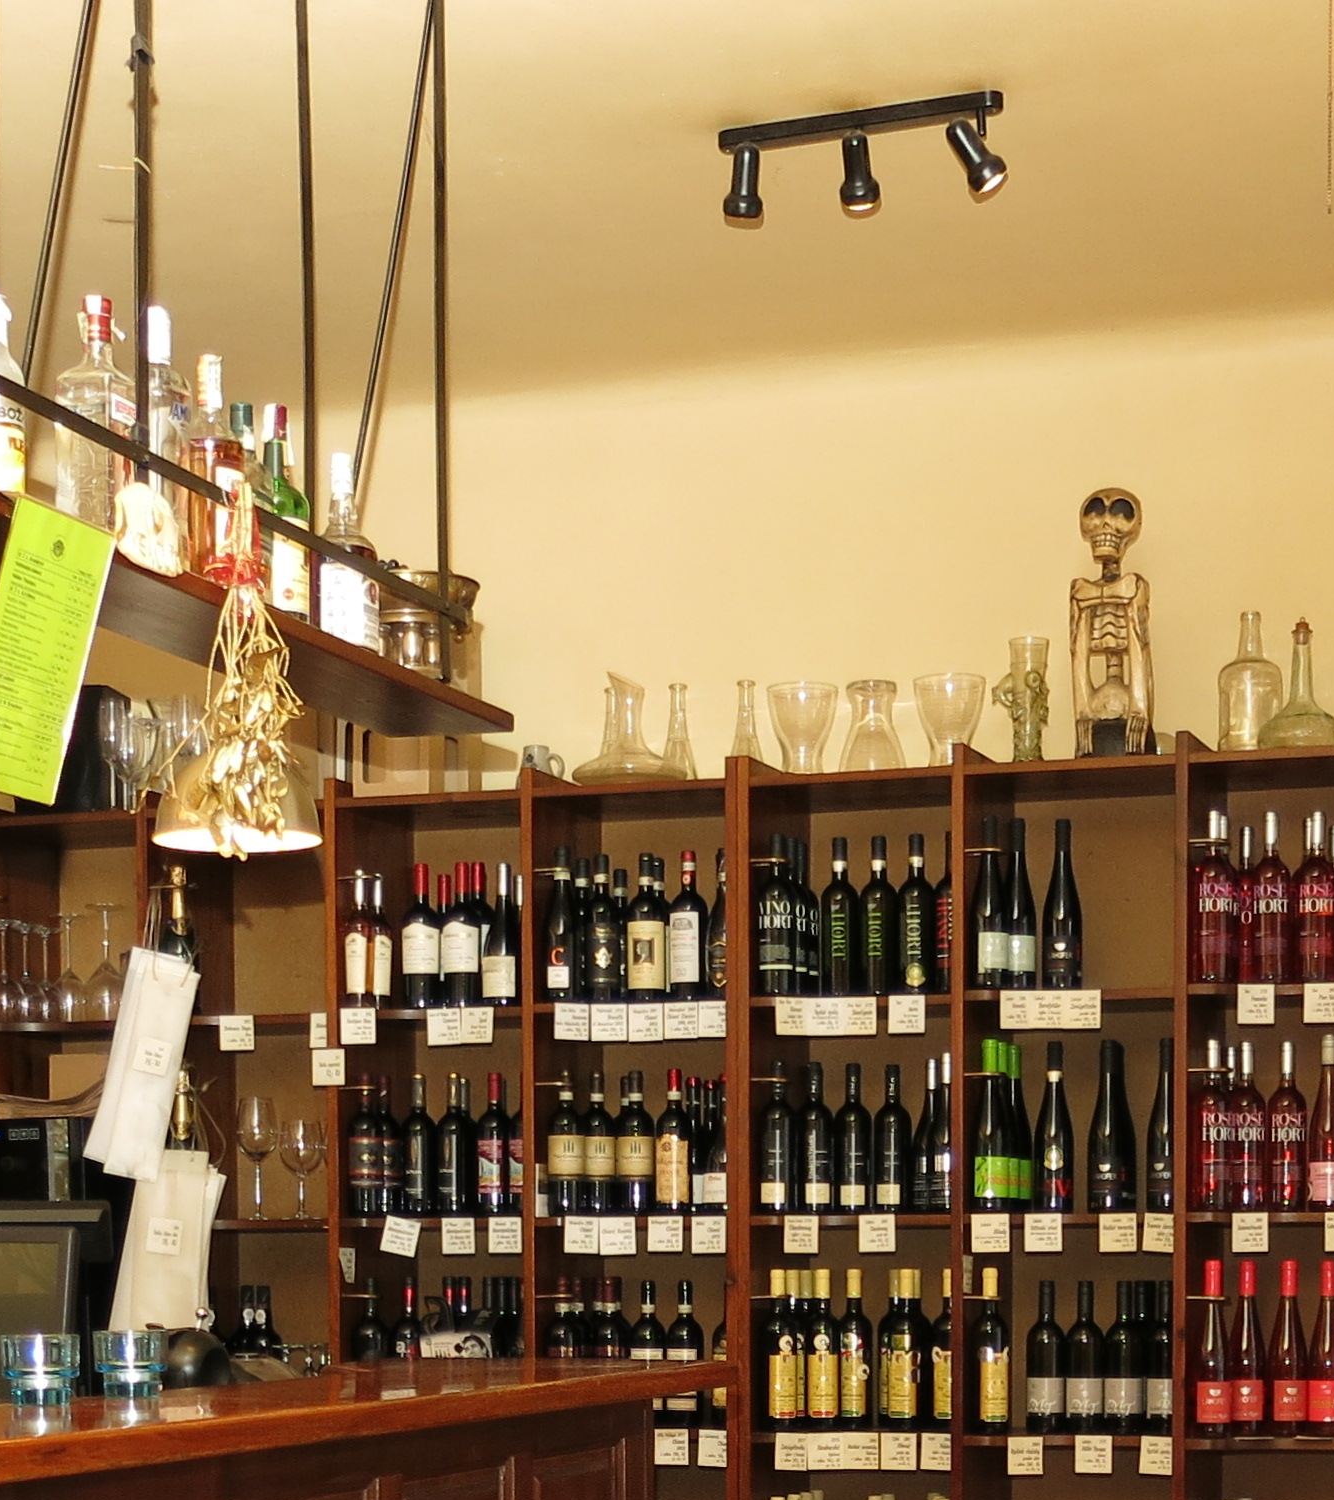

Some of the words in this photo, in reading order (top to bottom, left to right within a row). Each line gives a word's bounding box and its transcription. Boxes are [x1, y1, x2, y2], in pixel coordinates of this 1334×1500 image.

[759, 901, 791, 915] VINO
[1253, 898, 1289, 915] HORT
[1299, 898, 1334, 914] HORT
[758, 914, 794, 930] HORT
[1202, 1127, 1233, 1142] HOR
[1271, 1127, 1306, 1142] HORT
